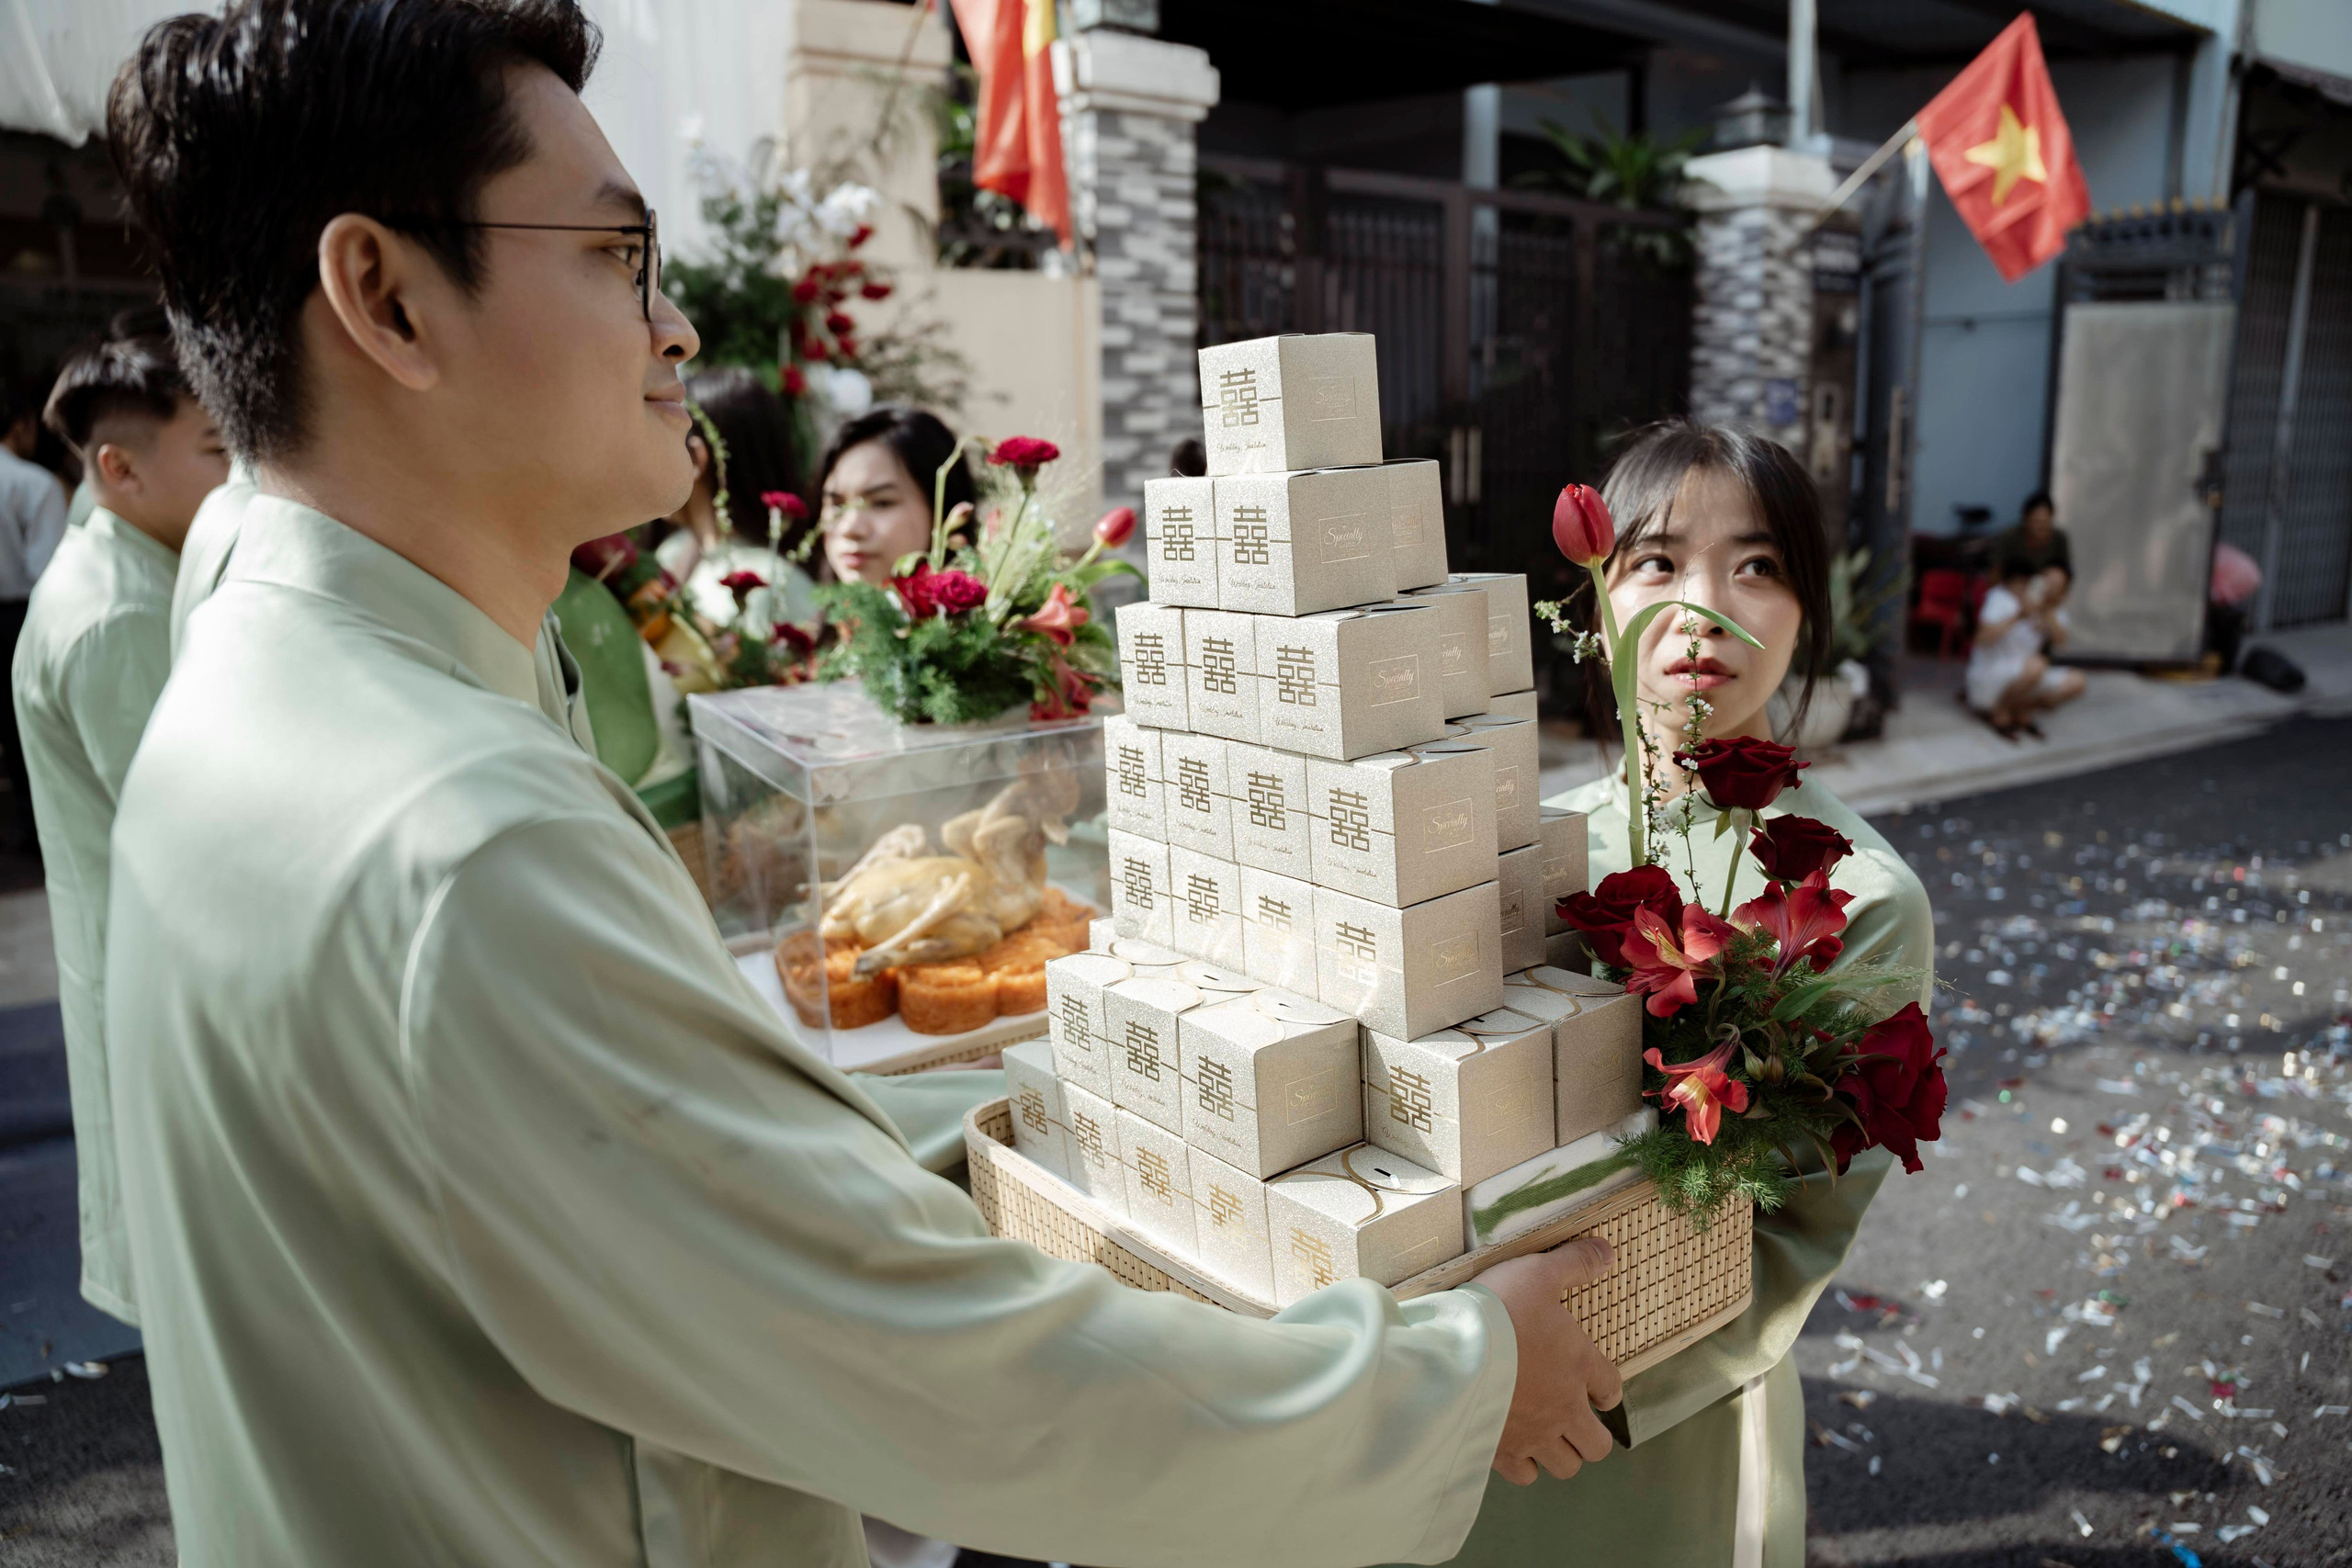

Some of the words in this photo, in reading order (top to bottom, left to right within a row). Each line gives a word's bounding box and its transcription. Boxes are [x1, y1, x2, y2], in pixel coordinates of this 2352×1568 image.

[1323, 526, 1363, 547] Specially
[1374, 669, 1415, 690] Specially
[1427, 812, 1468, 836] Specially
